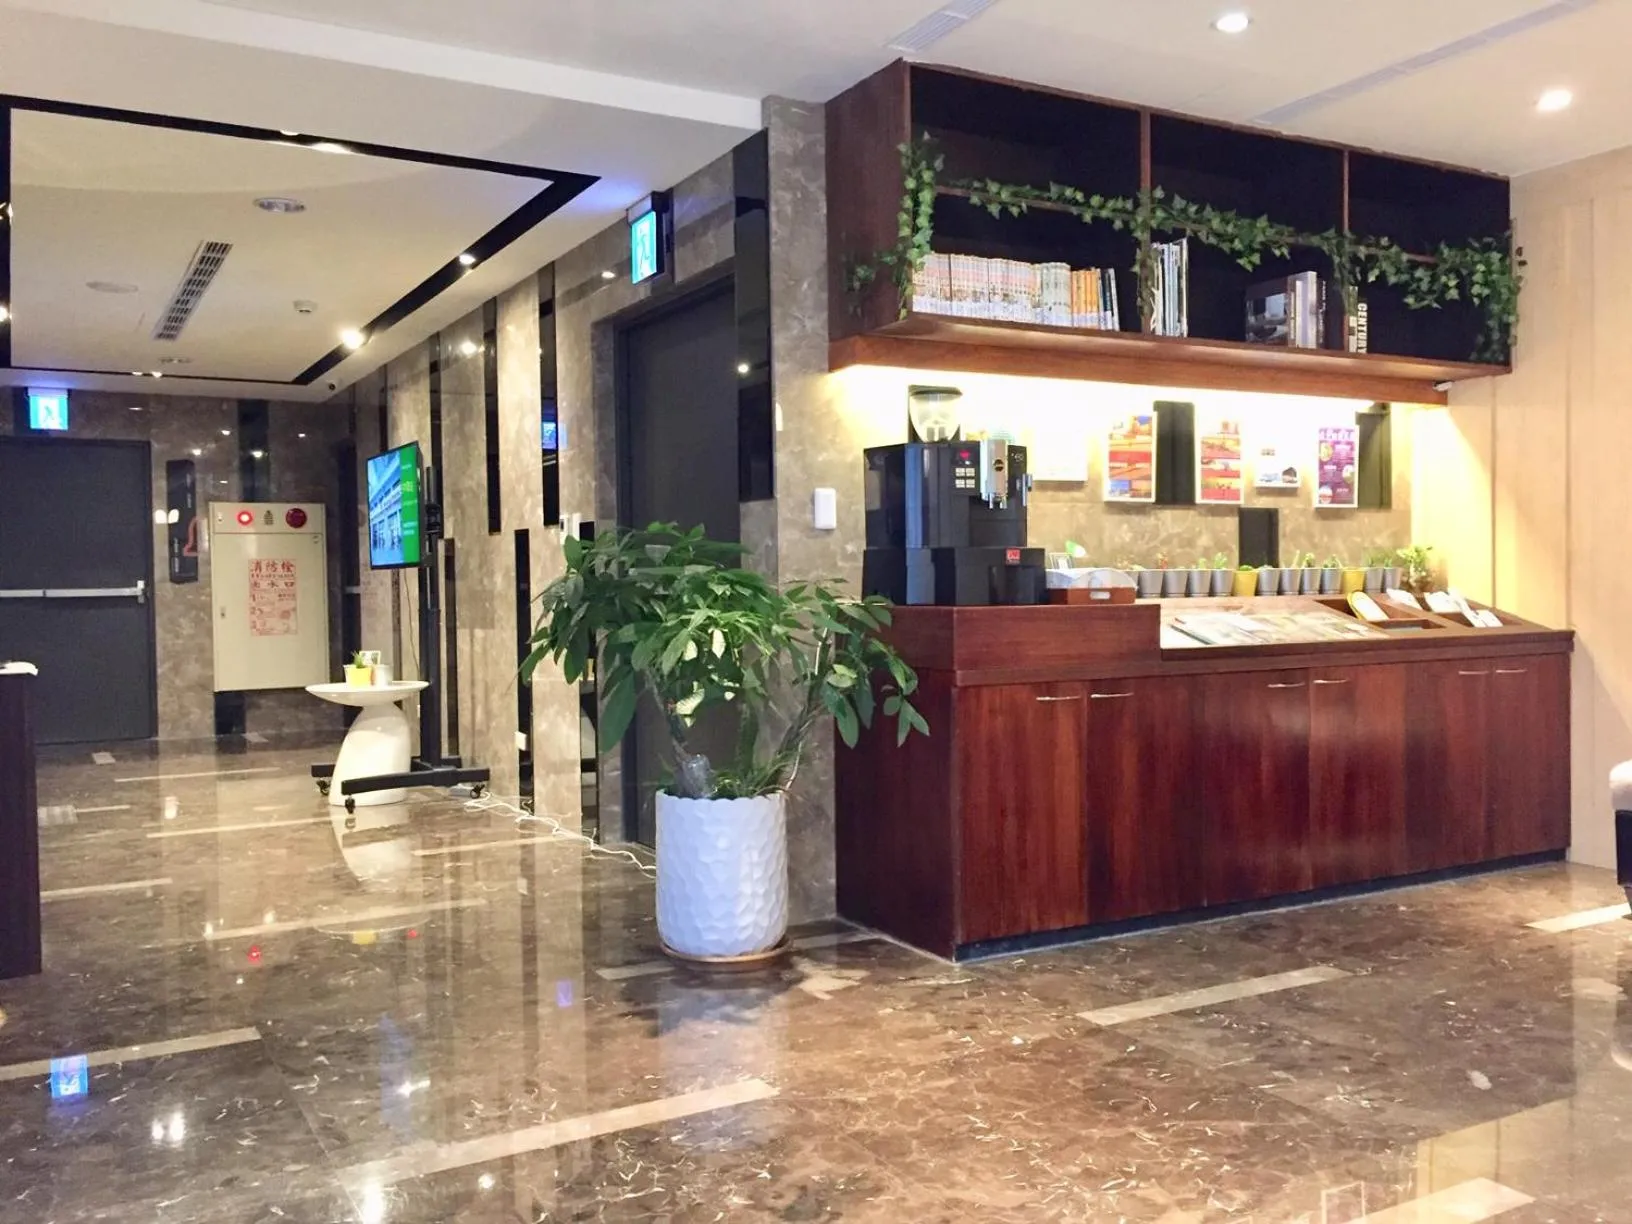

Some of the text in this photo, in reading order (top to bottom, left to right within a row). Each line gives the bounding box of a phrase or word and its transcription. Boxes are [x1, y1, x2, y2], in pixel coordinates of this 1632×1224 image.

[1357, 303, 1368, 353] CENTURY
[251, 560, 294, 574] 消防栓
